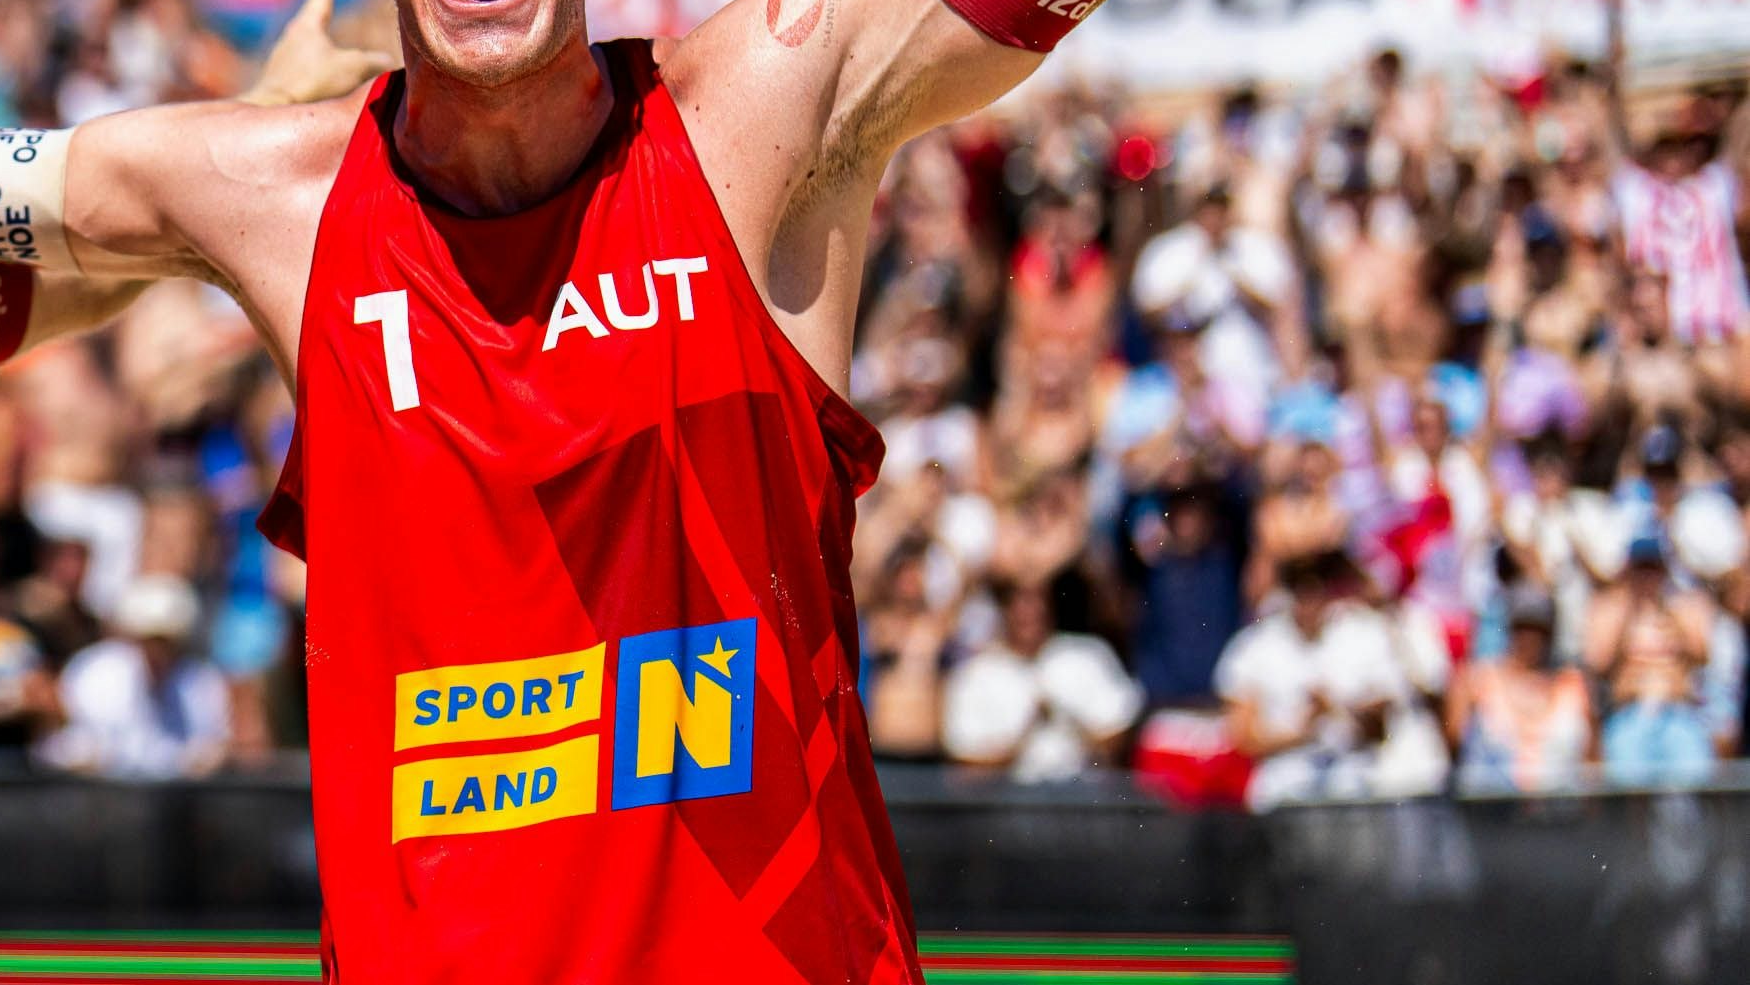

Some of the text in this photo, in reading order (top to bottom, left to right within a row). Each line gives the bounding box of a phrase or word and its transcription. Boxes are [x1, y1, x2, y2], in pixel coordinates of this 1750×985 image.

[6, 204, 42, 261] NOE
[542, 255, 709, 353] AUT
[353, 288, 421, 413] 1
[413, 670, 585, 727] SPORT
[635, 658, 732, 779] N
[420, 765, 558, 817] LAND
